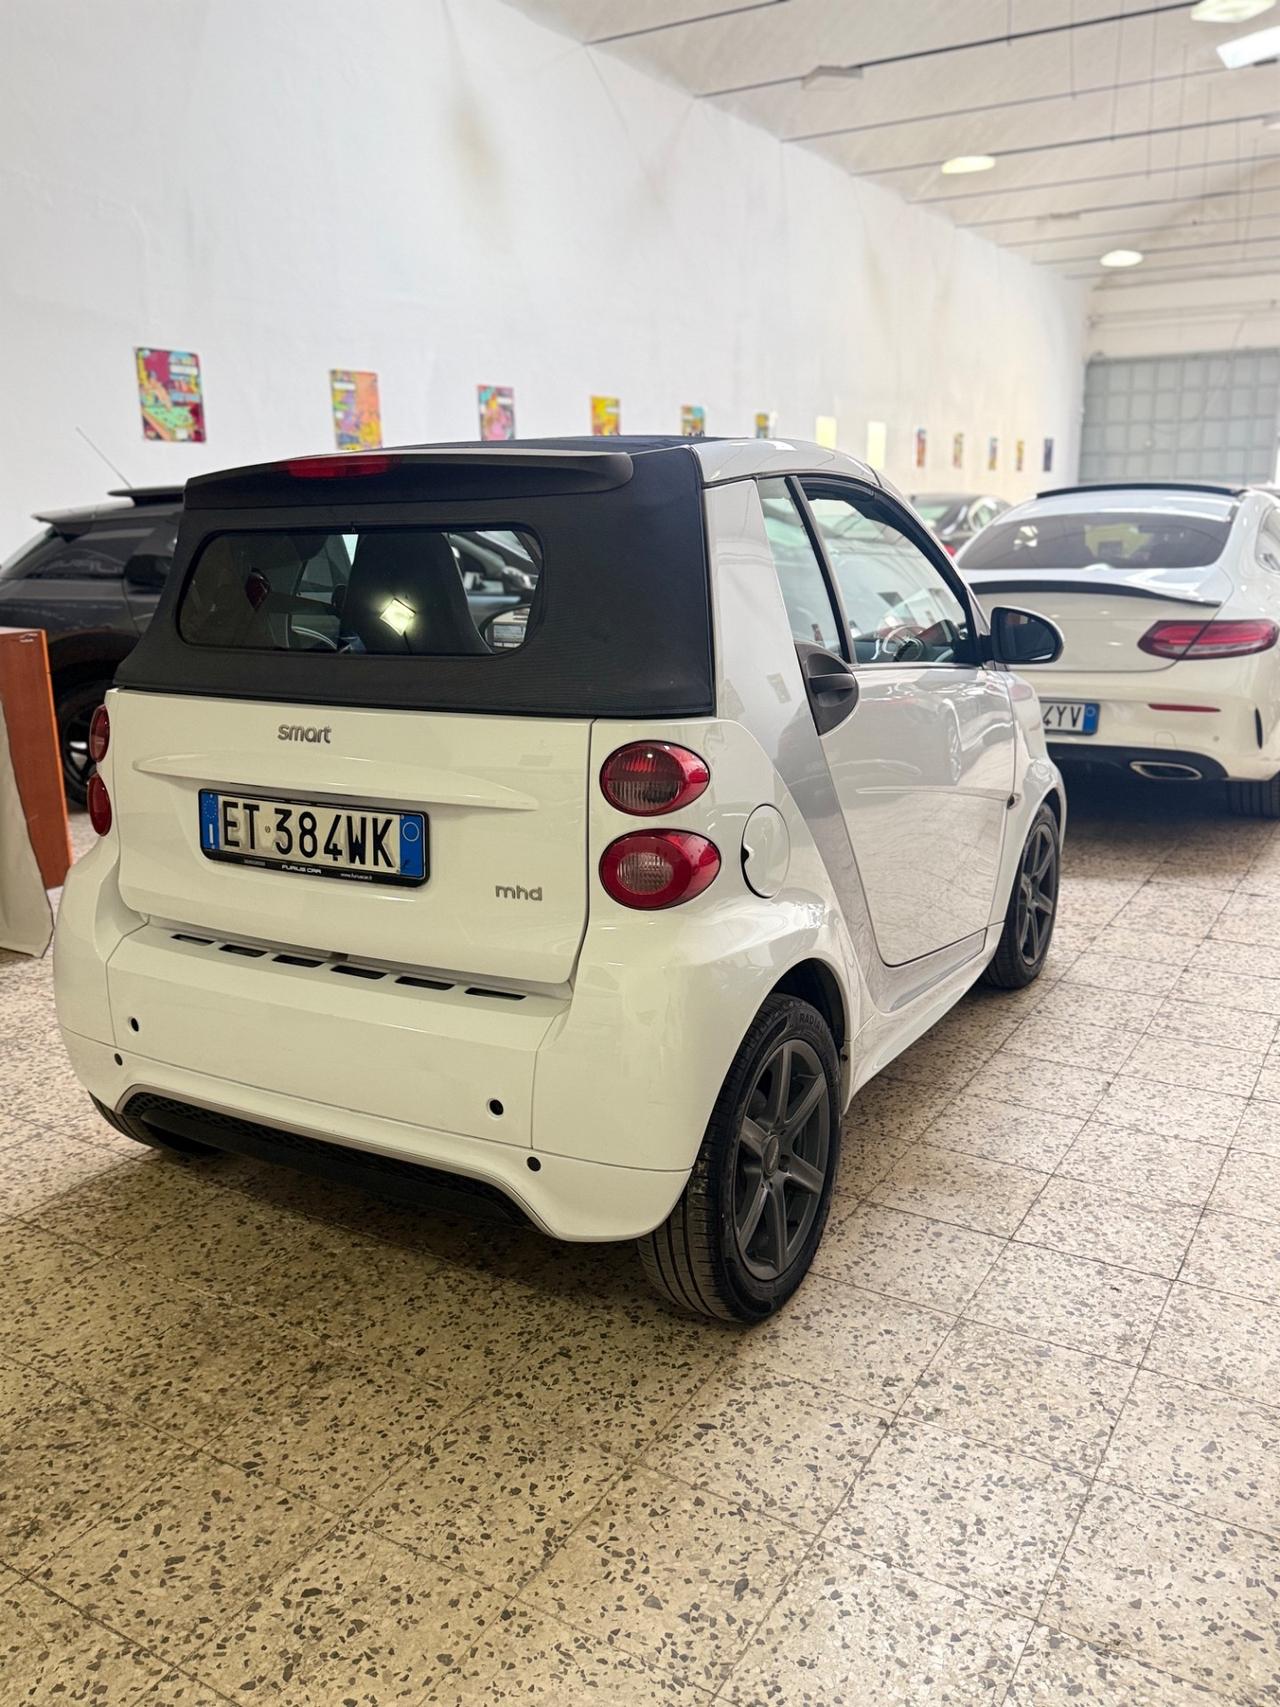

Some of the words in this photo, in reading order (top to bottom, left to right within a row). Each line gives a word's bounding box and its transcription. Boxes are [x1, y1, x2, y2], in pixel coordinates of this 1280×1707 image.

[278, 724, 332, 744] smart
[222, 800, 260, 850] ET
[273, 807, 396, 868] 384WK
[495, 884, 543, 902] mhd
